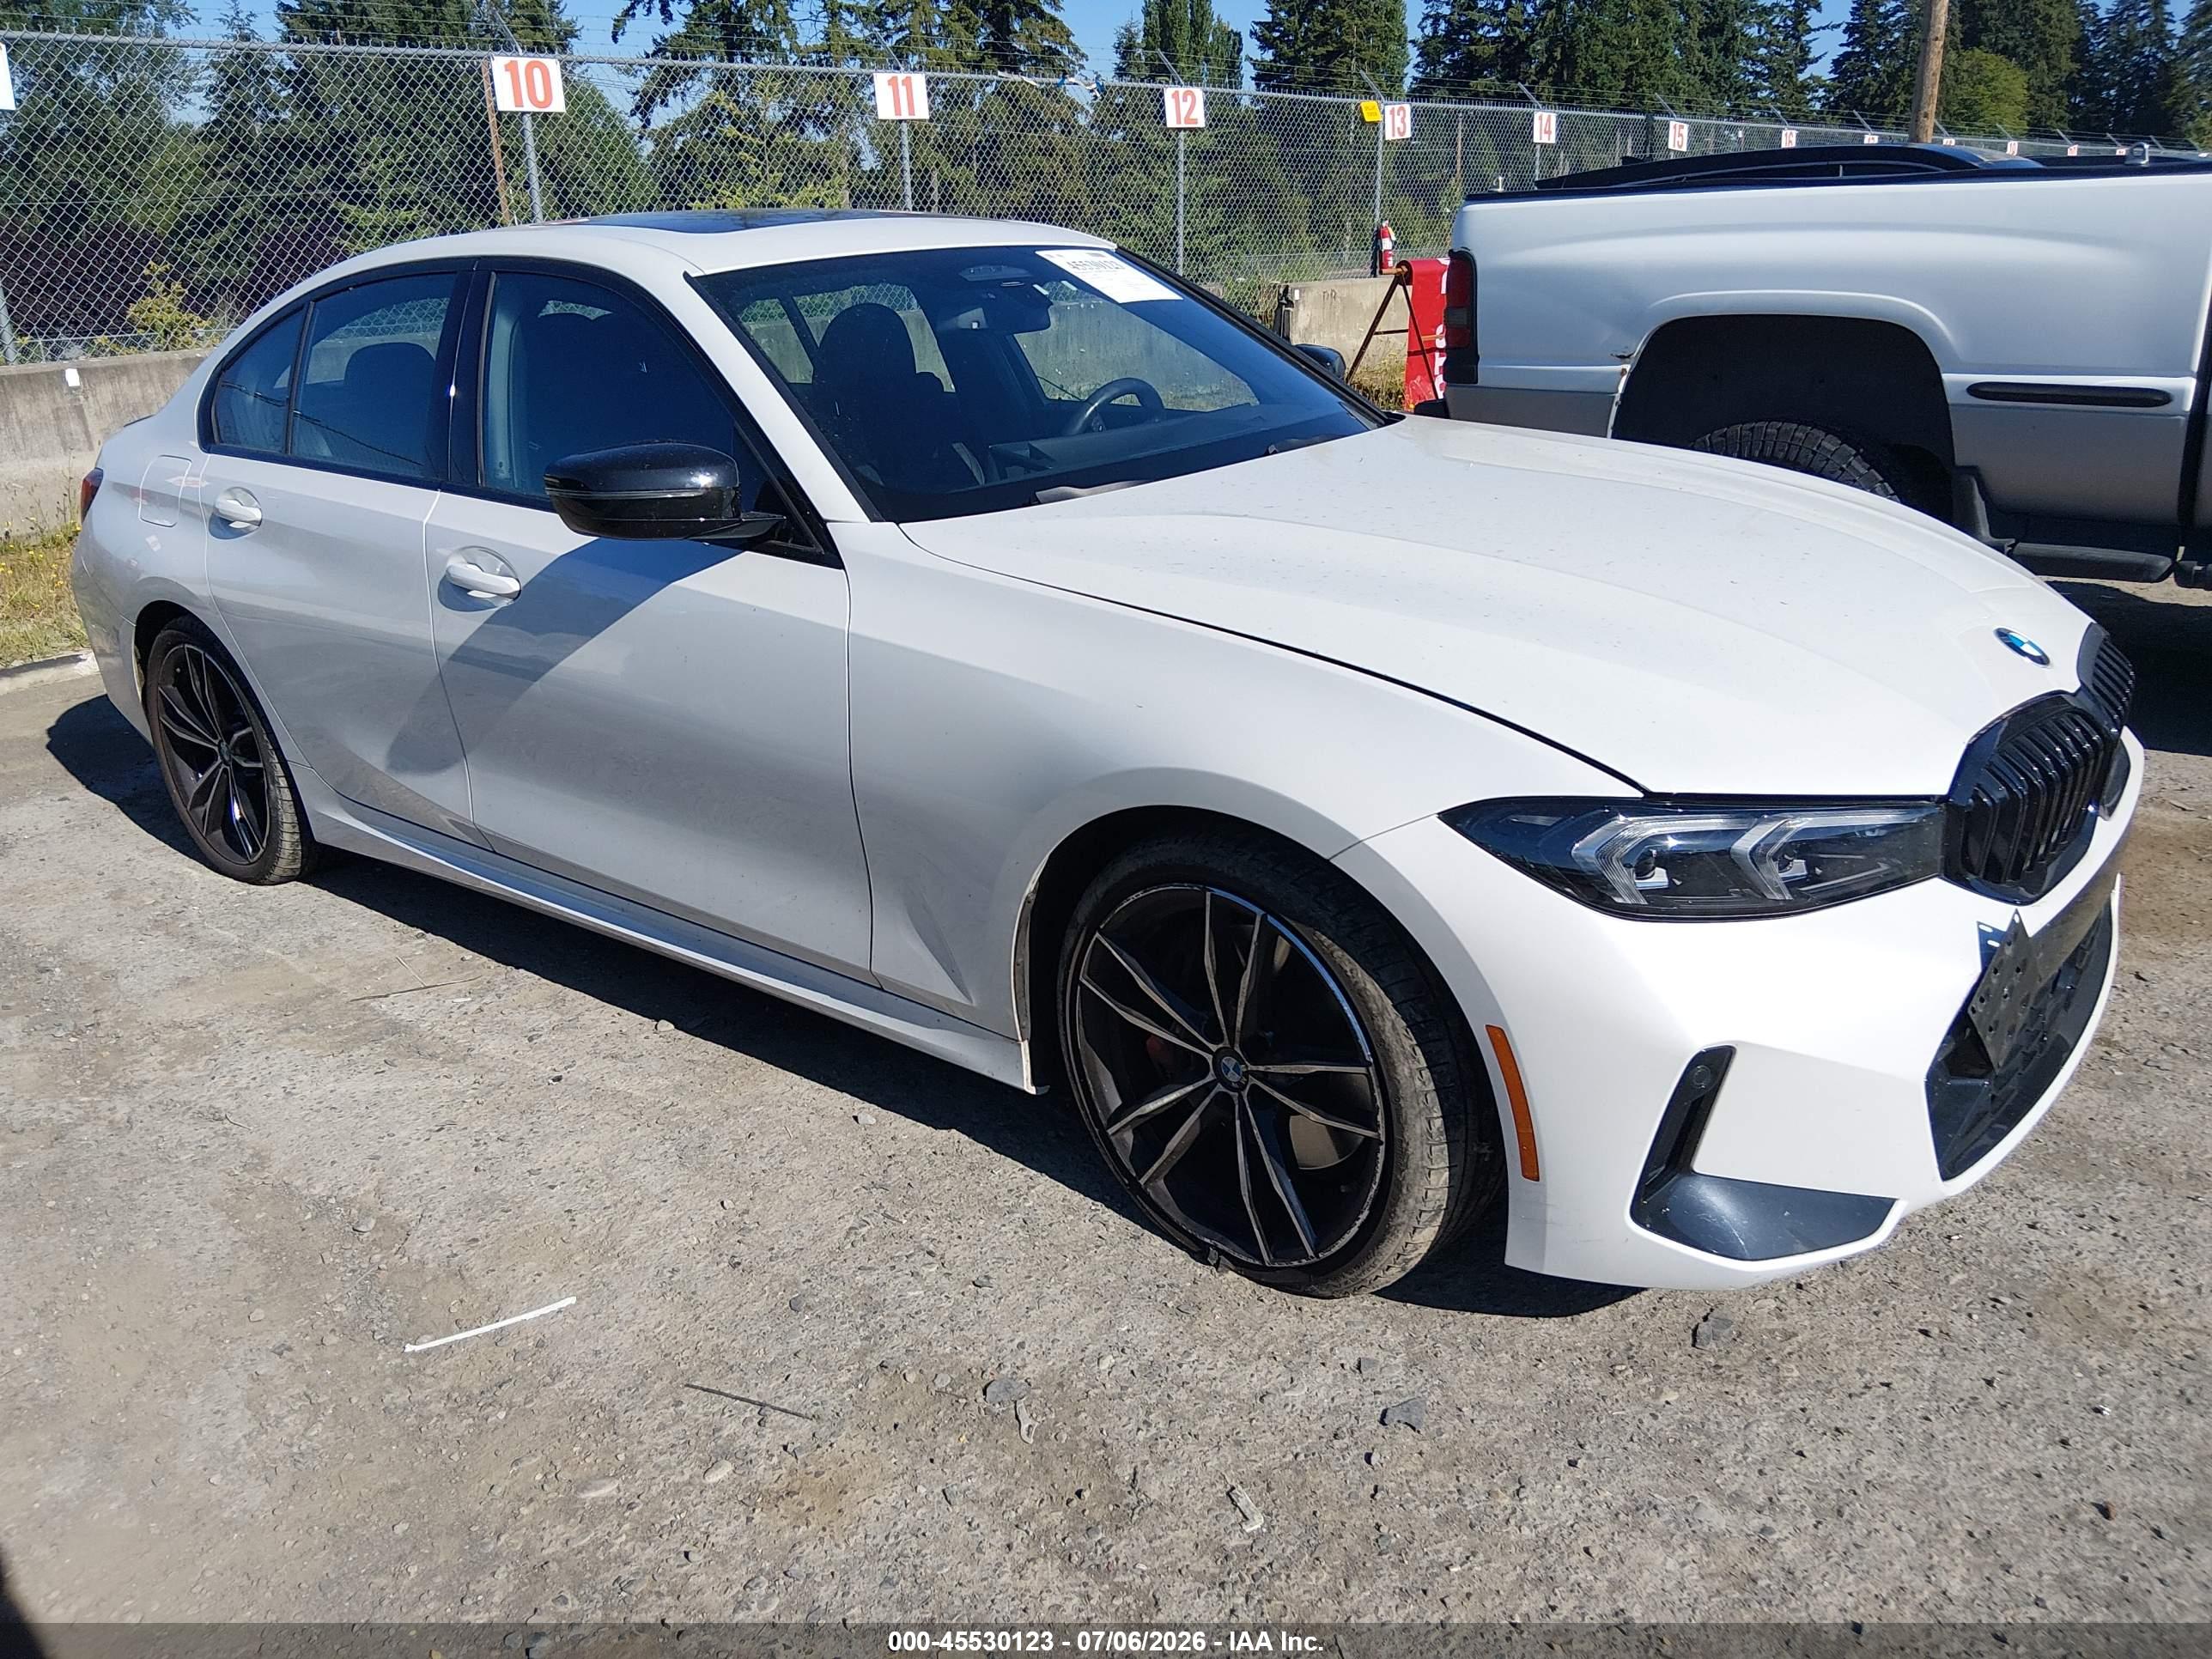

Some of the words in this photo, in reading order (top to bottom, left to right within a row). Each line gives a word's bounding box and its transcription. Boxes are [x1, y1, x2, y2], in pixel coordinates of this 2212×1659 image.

[504, 60, 553, 109] 10
[887, 75, 915, 116] 11
[1171, 89, 1198, 125] 12
[1389, 106, 1407, 137] 13
[1538, 113, 1553, 141] 14
[1673, 124, 1685, 149] 15
